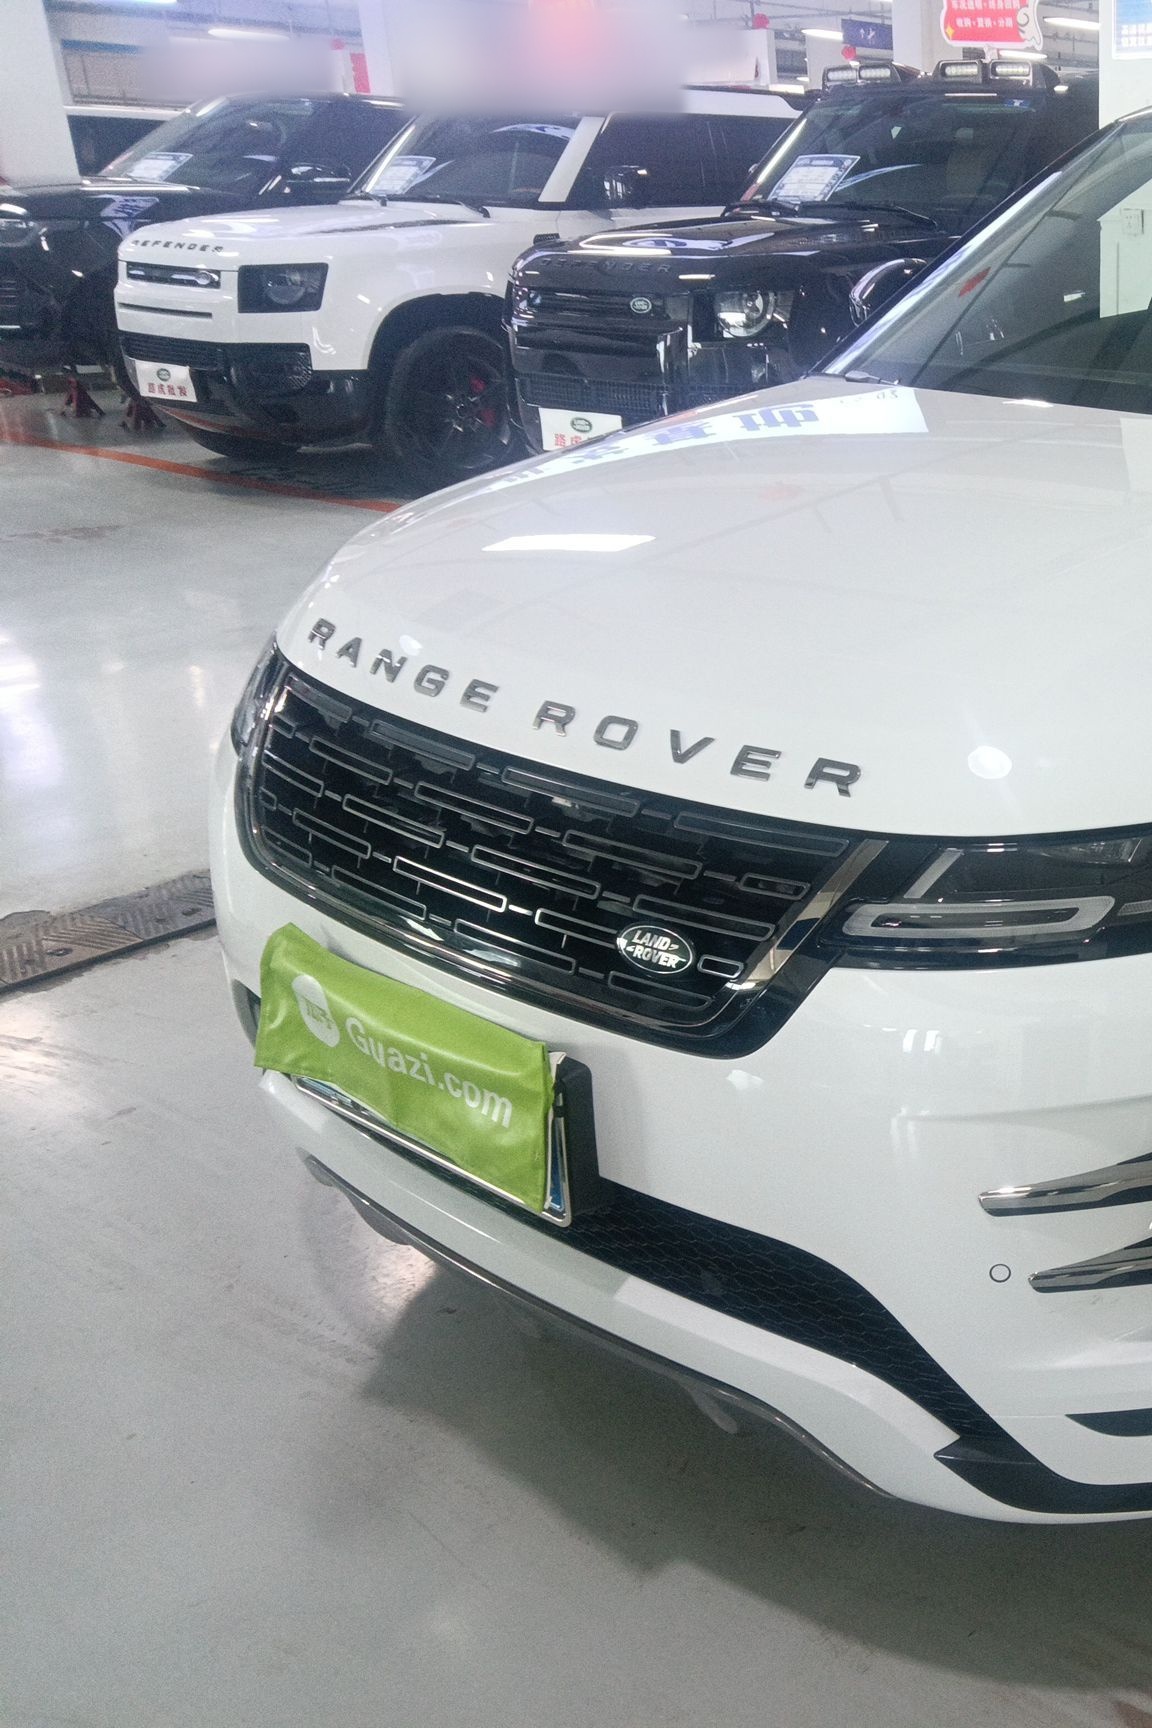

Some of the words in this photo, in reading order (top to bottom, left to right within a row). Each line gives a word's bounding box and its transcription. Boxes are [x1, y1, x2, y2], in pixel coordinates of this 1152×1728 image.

[308, 618, 499, 713] RANGE
[532, 700, 862, 798] ROVER
[632, 930, 671, 951] LAND
[632, 944, 680, 968] ROVER
[346, 1017, 513, 1128] Guazi.com
